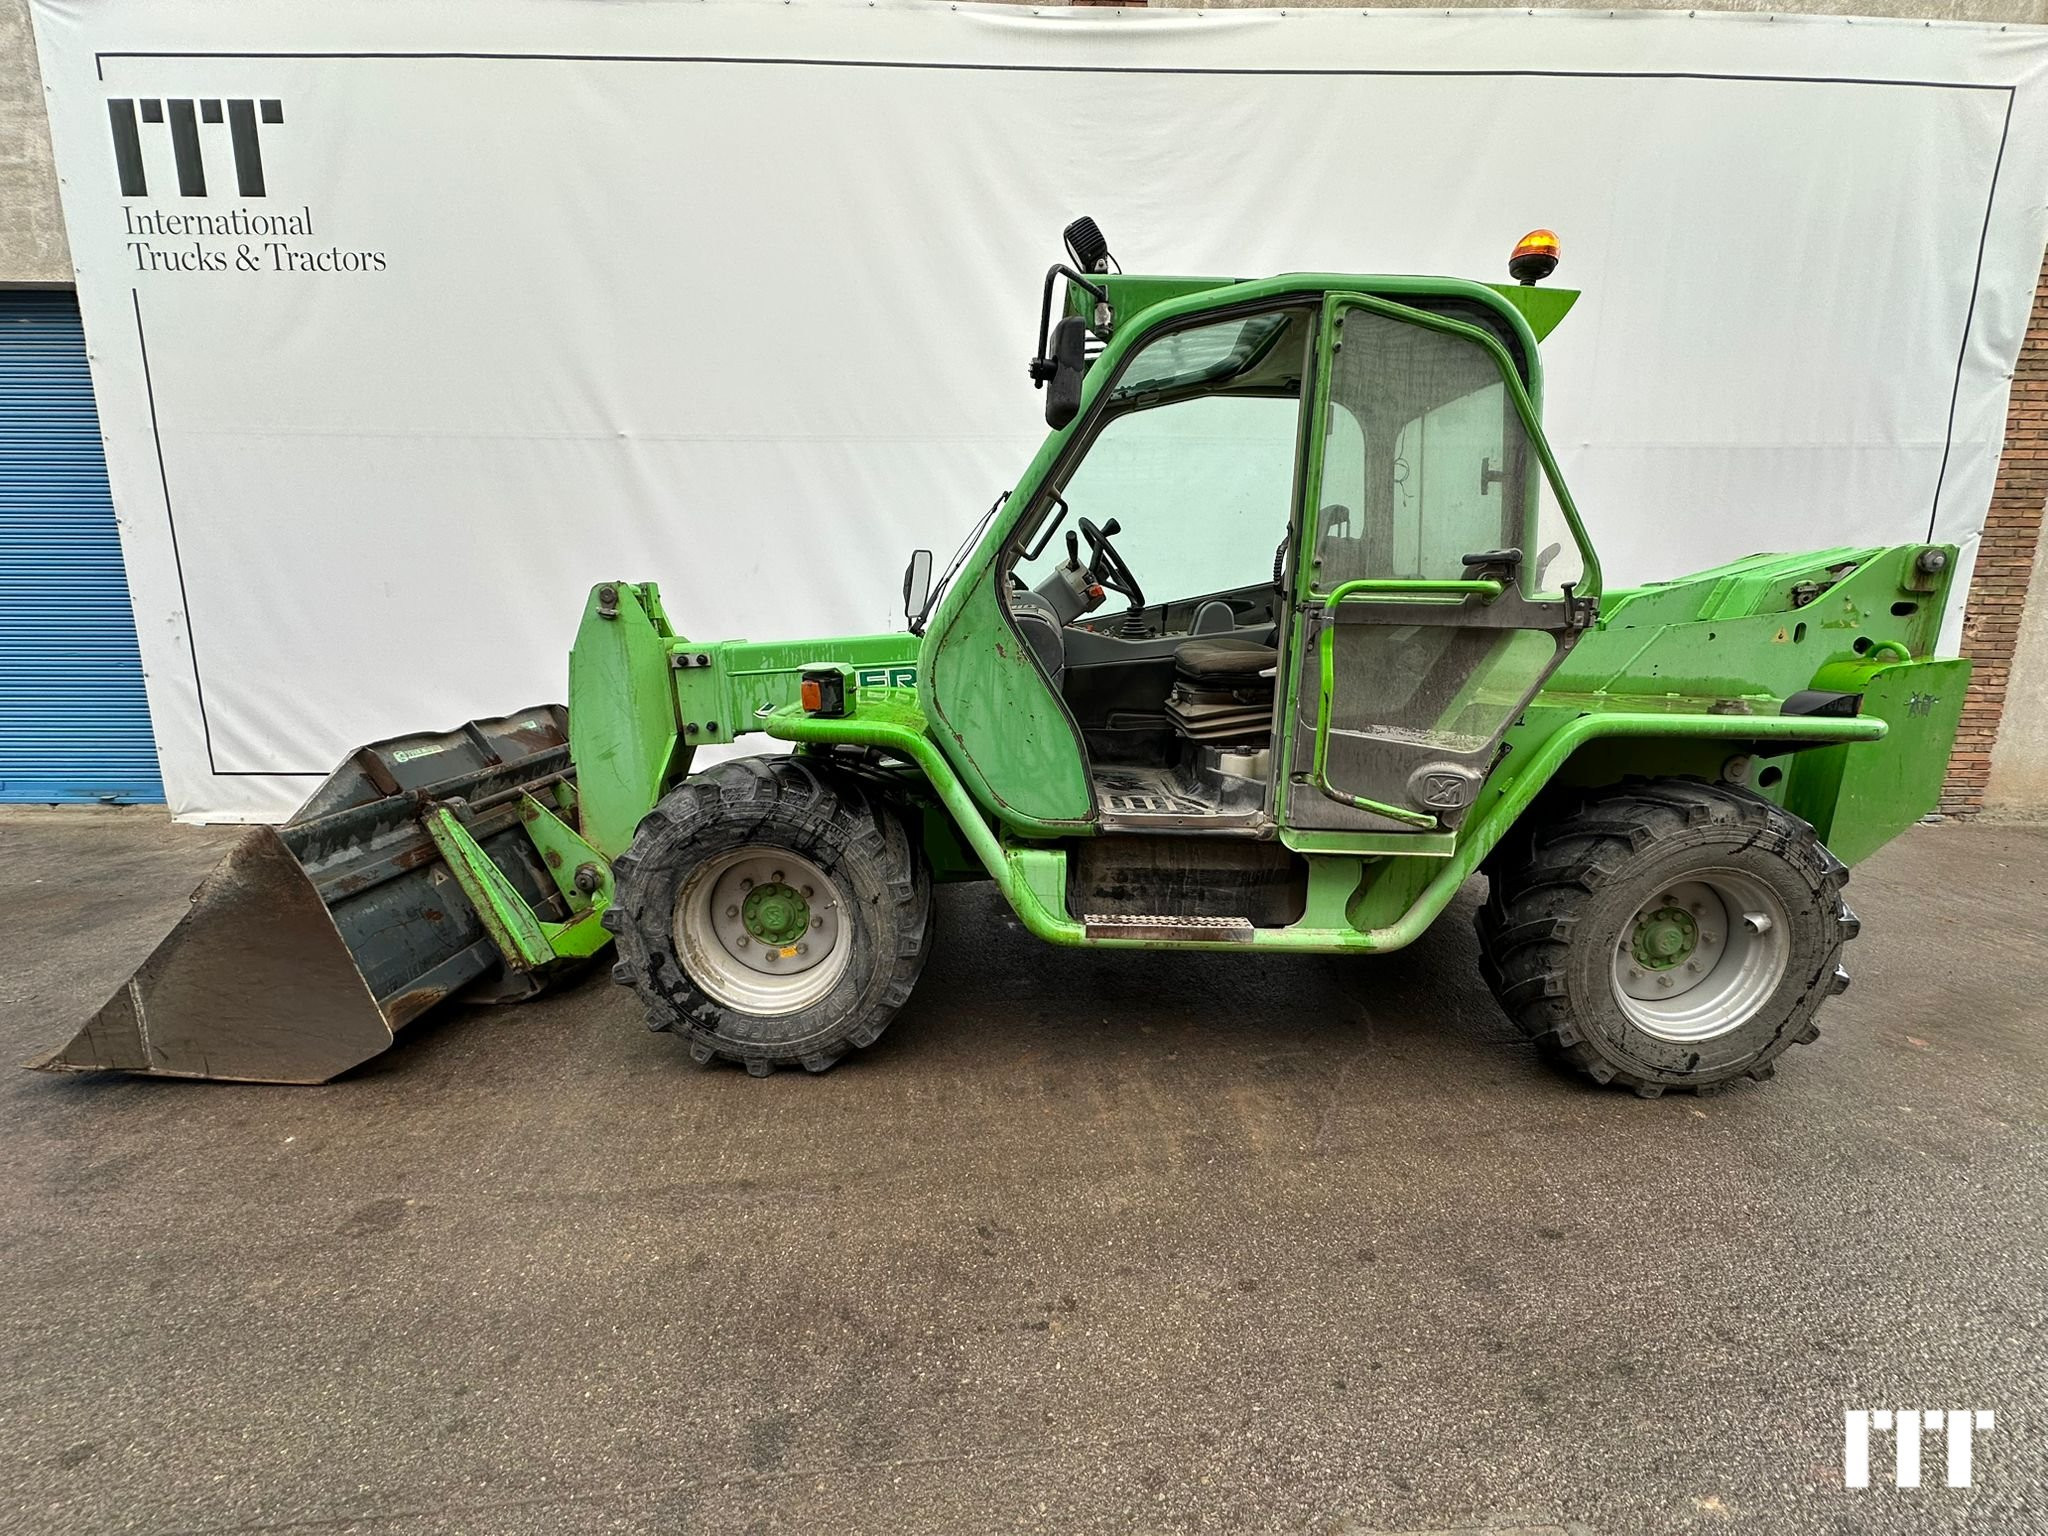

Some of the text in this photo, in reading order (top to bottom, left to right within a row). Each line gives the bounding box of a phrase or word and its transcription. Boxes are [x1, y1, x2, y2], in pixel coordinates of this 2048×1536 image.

[122, 205, 314, 236] International
[127, 242, 387, 272] Trucks & Tractors
